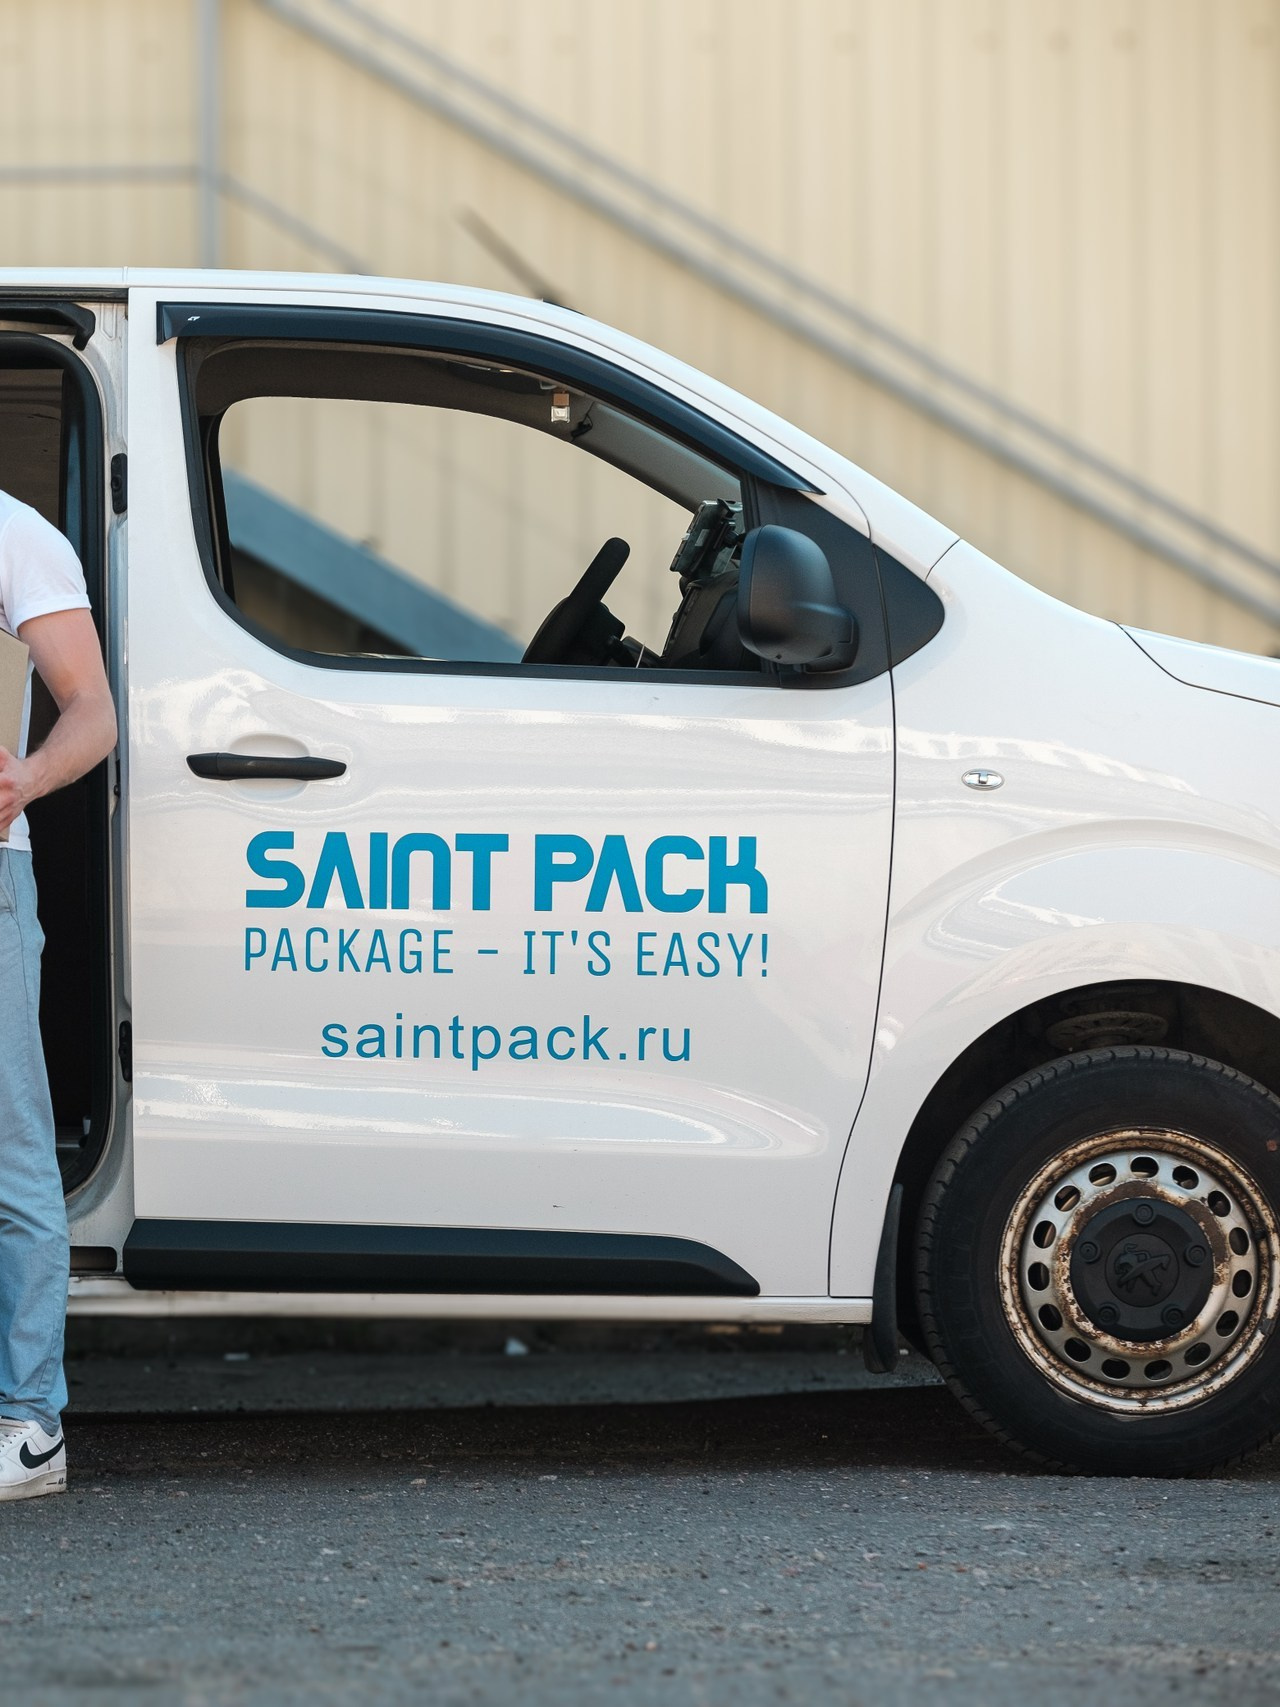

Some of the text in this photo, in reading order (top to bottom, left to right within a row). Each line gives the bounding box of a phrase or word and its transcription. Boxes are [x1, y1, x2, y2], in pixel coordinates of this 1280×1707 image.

[246, 830, 768, 914] SAINT PACK
[244, 926, 454, 974] PACKAGE
[523, 929, 612, 976] IT'S
[636, 931, 769, 977] EASY!
[321, 1012, 691, 1071] saintpack.ru
